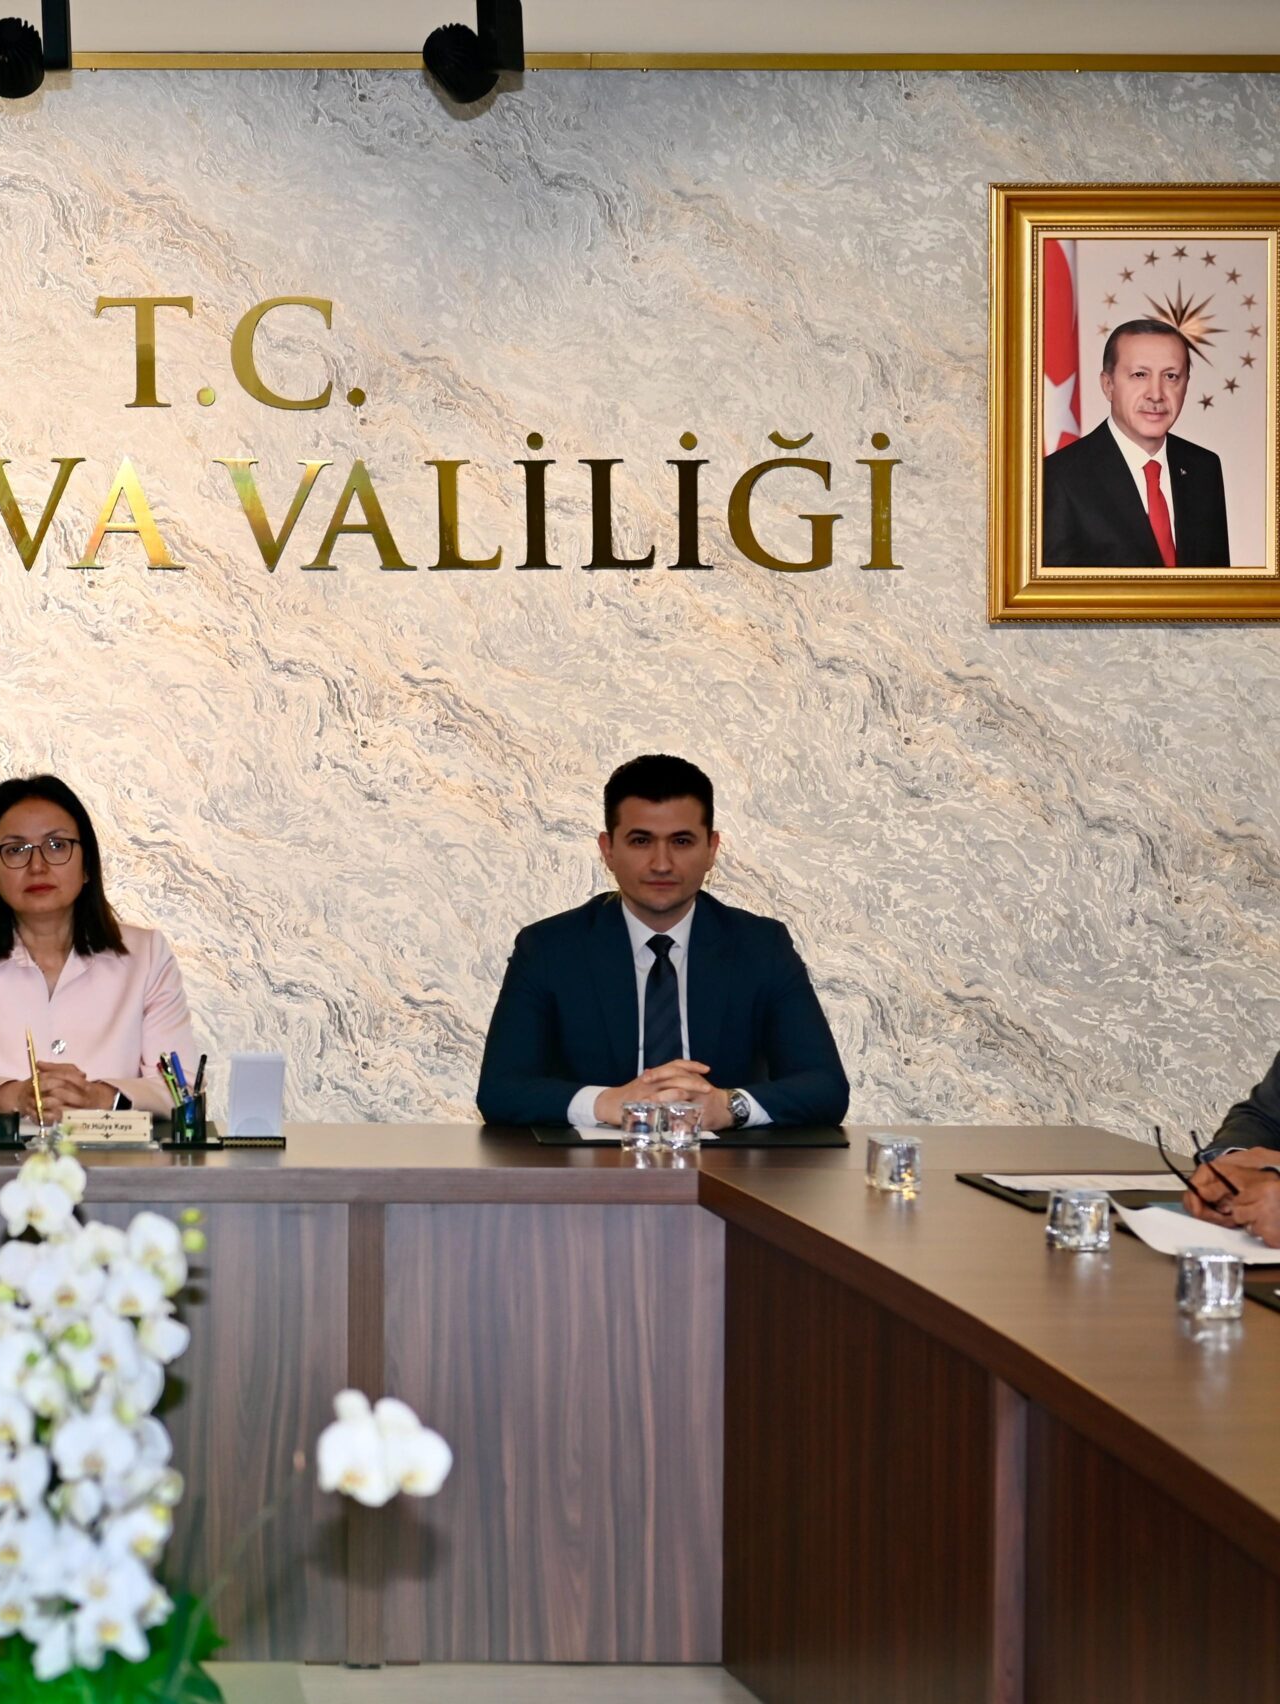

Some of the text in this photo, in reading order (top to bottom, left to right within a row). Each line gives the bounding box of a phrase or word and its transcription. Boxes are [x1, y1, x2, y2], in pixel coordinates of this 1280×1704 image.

[95, 295, 366, 410] T.C.
[212, 430, 904, 572] VALİLİĞİ
[114, 1122, 132, 1131] Kaya
